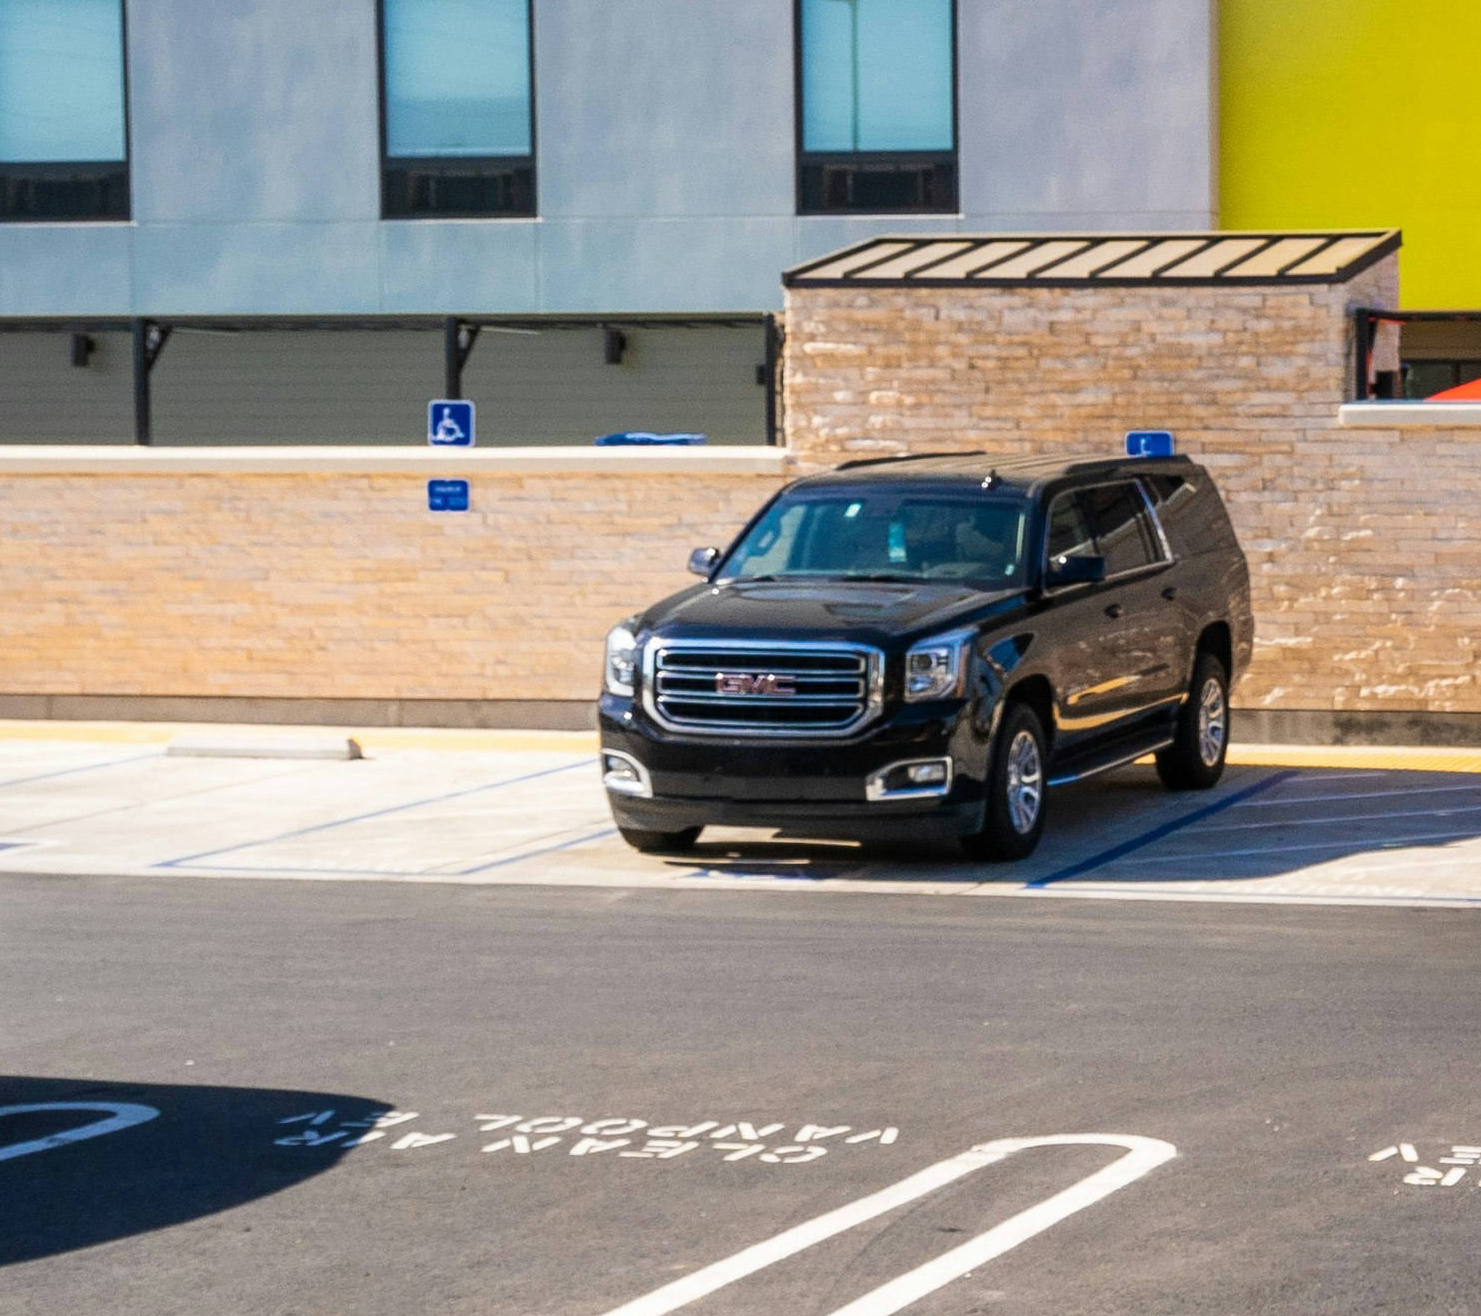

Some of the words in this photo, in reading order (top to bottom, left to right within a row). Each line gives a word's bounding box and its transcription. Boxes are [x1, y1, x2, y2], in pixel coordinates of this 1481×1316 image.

[715, 672, 797, 695] GMC
[272, 1130, 459, 1150] AIR
[473, 1113, 900, 1145] VANPOOL
[480, 1134, 829, 1164] CLEAN
